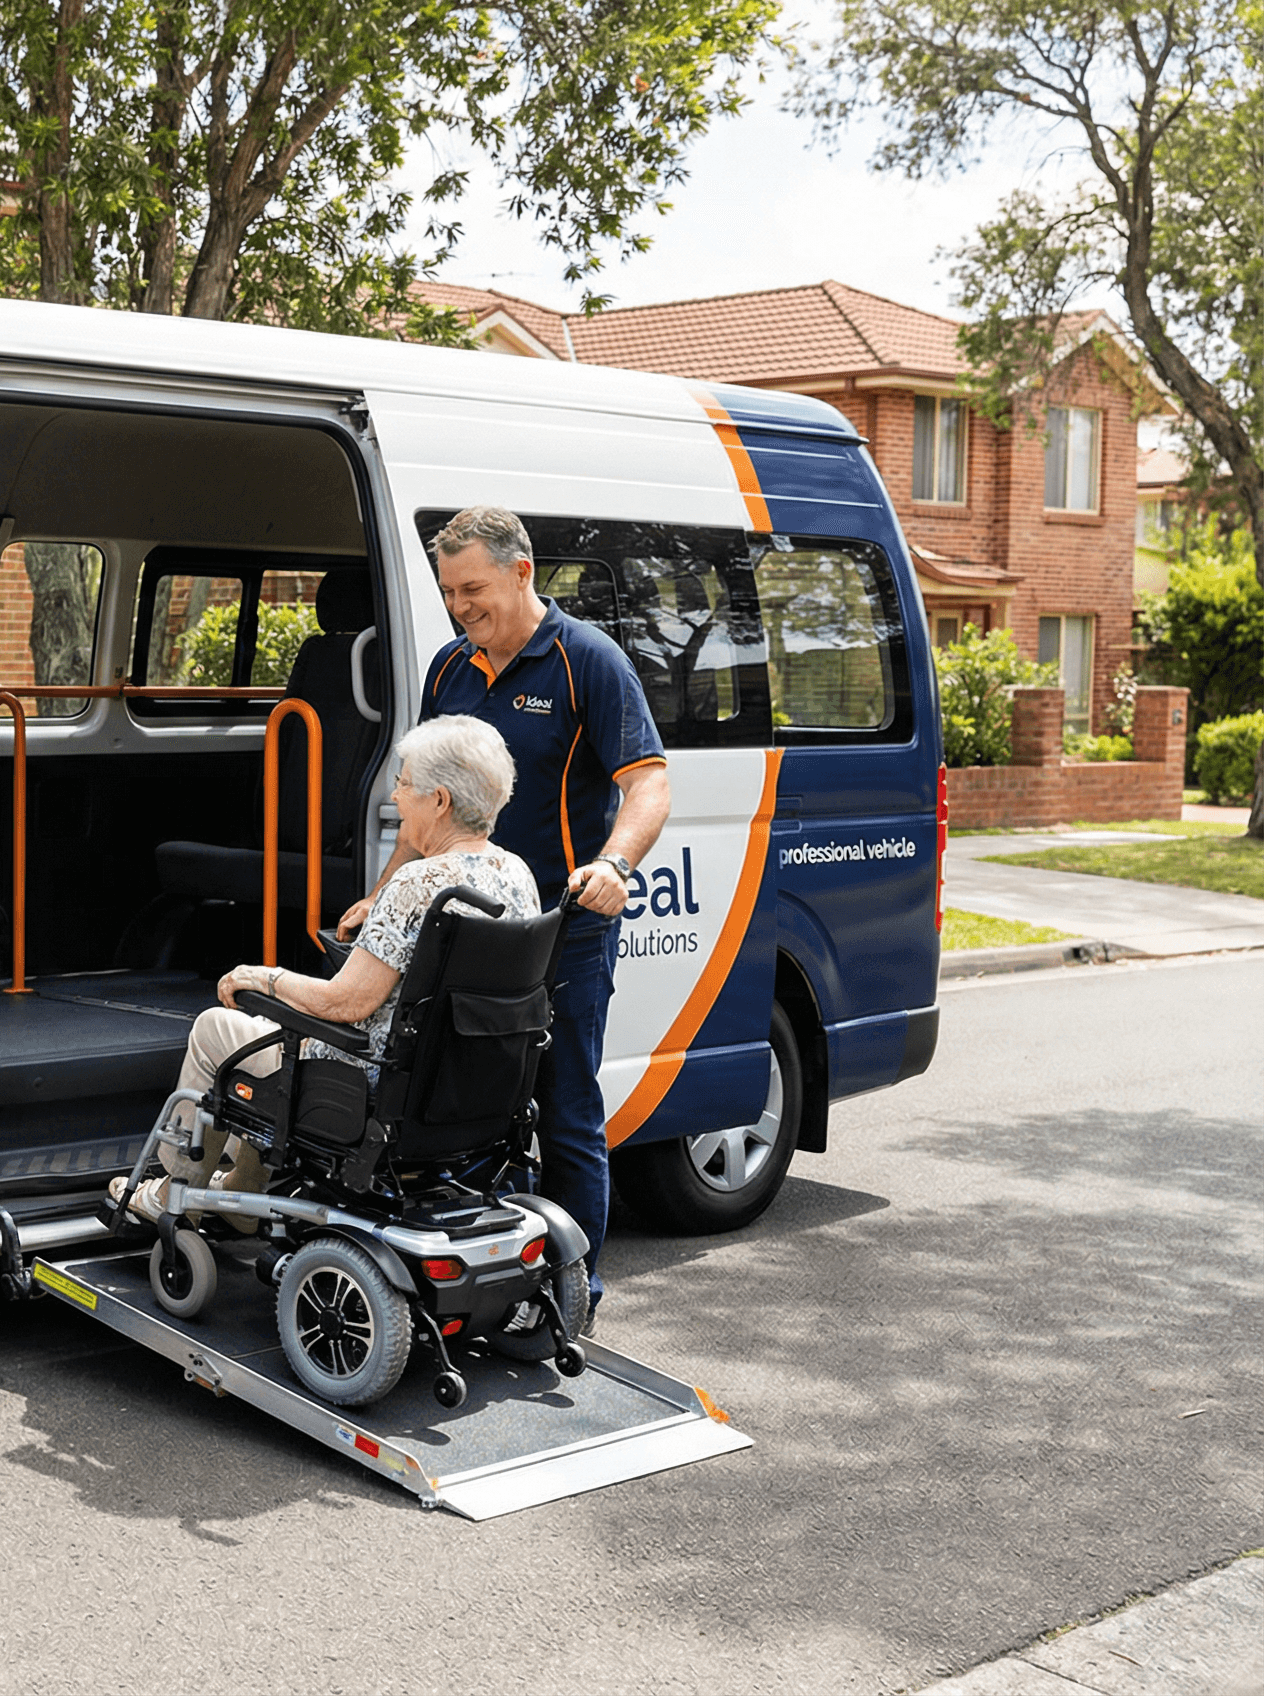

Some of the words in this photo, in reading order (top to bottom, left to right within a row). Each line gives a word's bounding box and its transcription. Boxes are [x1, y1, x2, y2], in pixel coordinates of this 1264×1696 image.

[779, 839, 866, 870] professional
[867, 836, 916, 860] vehicle
[621, 846, 700, 920] eal
[617, 928, 698, 959] olutions
